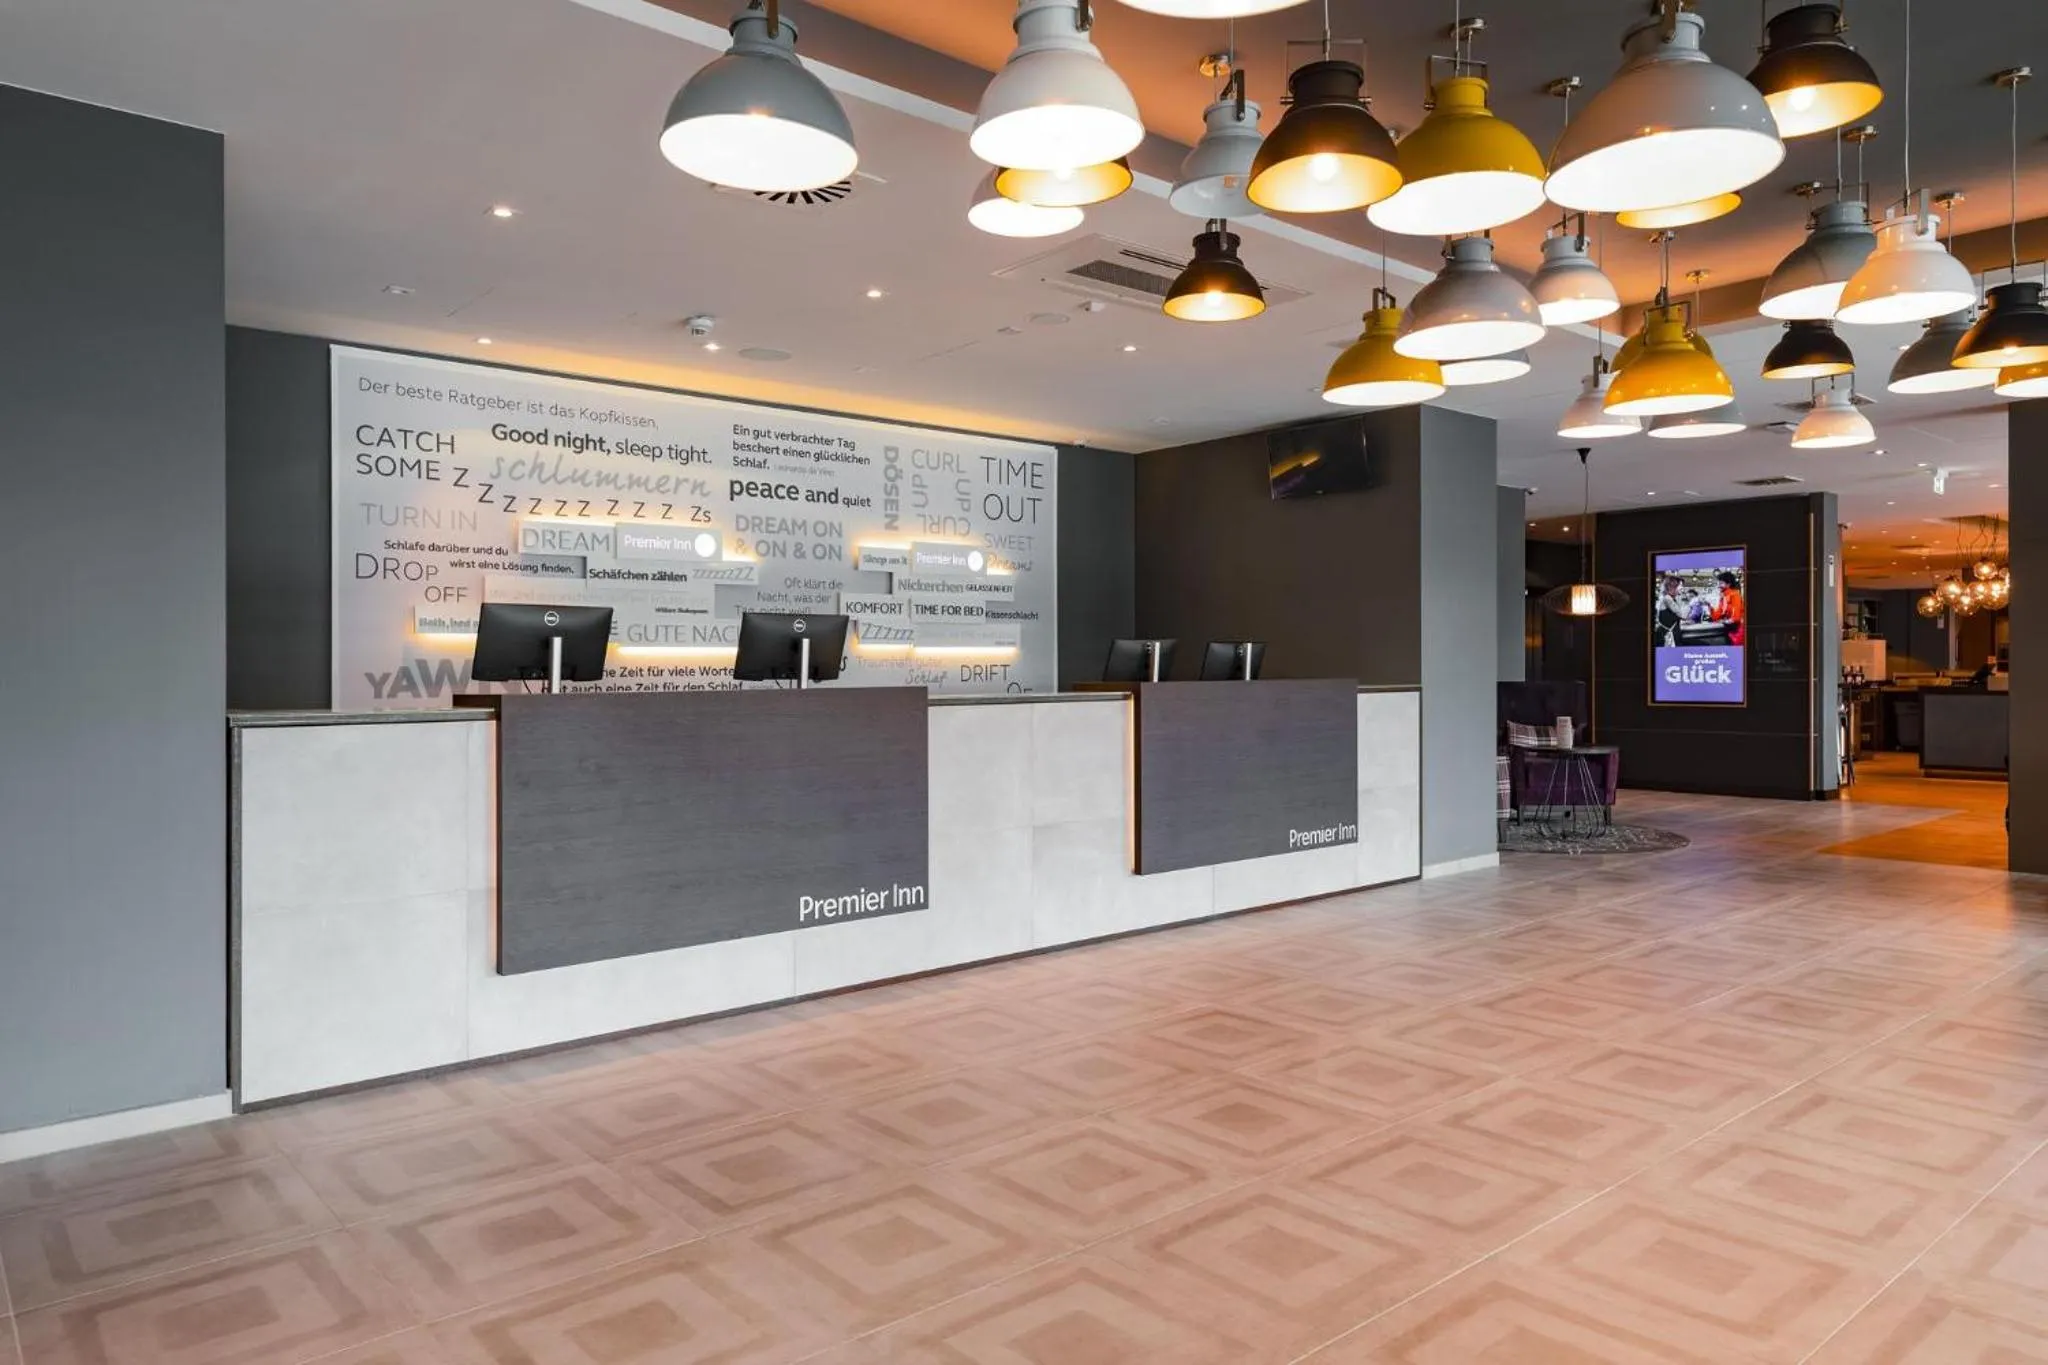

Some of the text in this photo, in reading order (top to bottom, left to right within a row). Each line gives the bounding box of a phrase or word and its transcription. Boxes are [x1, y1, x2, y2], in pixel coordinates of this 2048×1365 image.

[358, 376, 390, 394] Der
[396, 381, 443, 402] beste
[448, 389, 521, 414] Ratgeber
[527, 399, 544, 415] ist
[549, 403, 576, 419] das
[355, 424, 455, 455] CATCH
[491, 423, 712, 466] Good night, sleep tight.
[732, 424, 856, 451] Ein gut verbrachter Tag
[732, 441, 871, 465] beschert einen glücklichen
[732, 456, 770, 470] Schlaf.
[911, 449, 967, 474] CURL
[355, 453, 441, 481] SOME
[488, 450, 711, 498] schlummern
[980, 456, 1044, 490] TIME
[730, 478, 872, 509] peace and quiet
[884, 445, 903, 531] DÖSEN
[360, 502, 478, 532] TURN IN
[983, 493, 1043, 524] OUT
[735, 514, 843, 538] DREAM ON
[384, 539, 509, 556] Schlafe darüber und du
[522, 528, 611, 553] DREAM
[623, 534, 691, 552] Premier Inn
[755, 539, 787, 559] ON
[793, 542, 807, 560] &
[812, 544, 842, 561] ON
[985, 532, 1035, 552] SWEET
[355, 552, 440, 582] DROP
[449, 559, 475, 569] wirst
[478, 561, 501, 570] eine
[502, 561, 539, 574] Lösung
[589, 568, 649, 582] Schäfchen
[651, 569, 688, 583] zählen
[424, 585, 468, 603] OFF
[898, 578, 964, 594] Nickerchen
[845, 601, 904, 615] KOMFORT
[914, 604, 940, 616] TIME
[941, 604, 962, 617] FOR
[963, 605, 984, 617] BED
[627, 623, 688, 643] GUTE
[619, 666, 644, 677] Zeit
[647, 665, 664, 678] für
[667, 665, 695, 677] viele
[960, 664, 1011, 683] DRIFT
[1665, 664, 1732, 684] Glück
[1289, 822, 1357, 849] Premier Inn
[799, 883, 925, 922] Premier Inn
